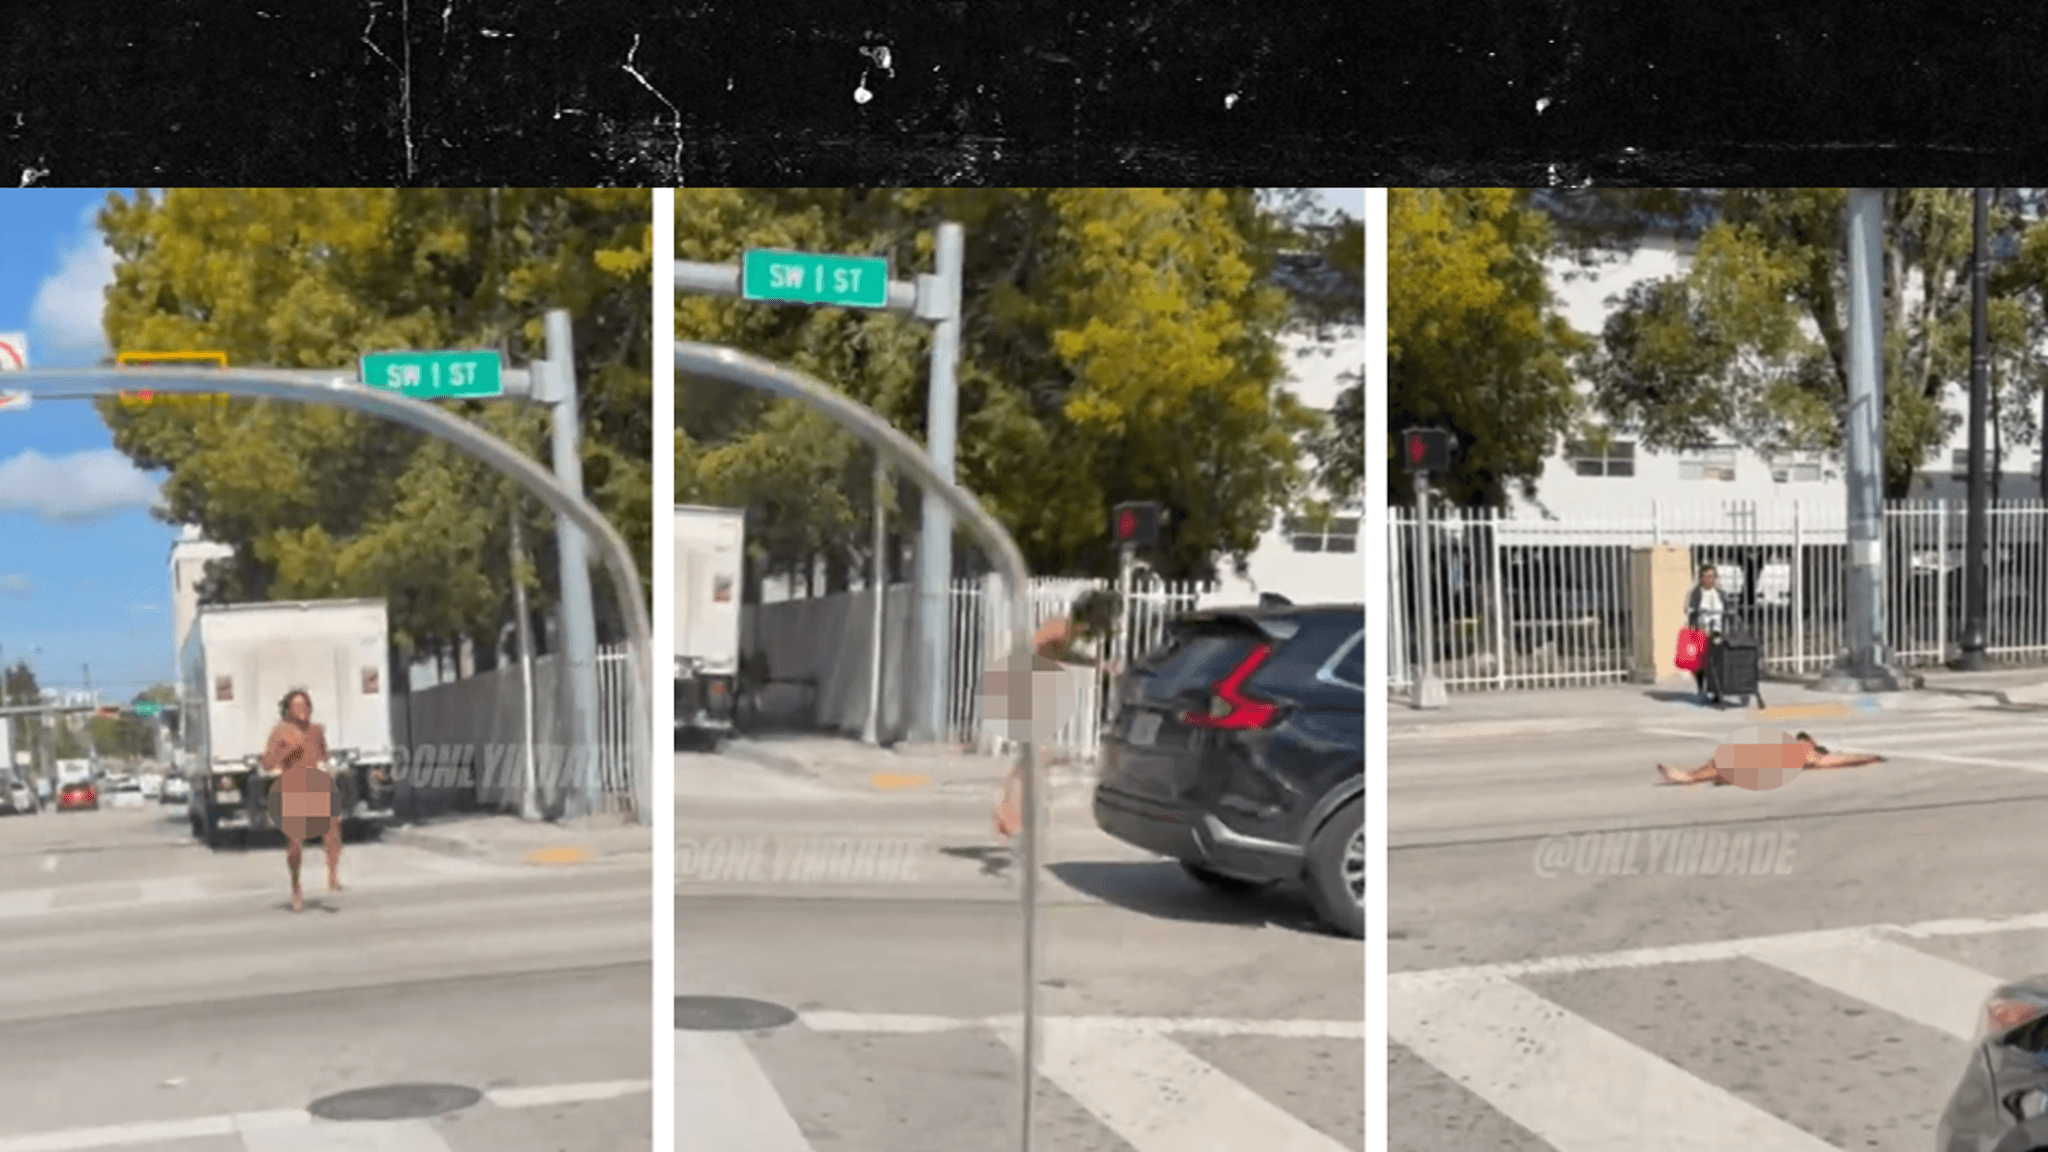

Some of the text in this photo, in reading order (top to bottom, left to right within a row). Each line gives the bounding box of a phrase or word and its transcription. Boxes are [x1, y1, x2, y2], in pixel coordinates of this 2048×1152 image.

[768, 262, 806, 290] SW
[833, 267, 863, 294] ST
[386, 363, 421, 389] SW
[448, 361, 477, 387] ST
